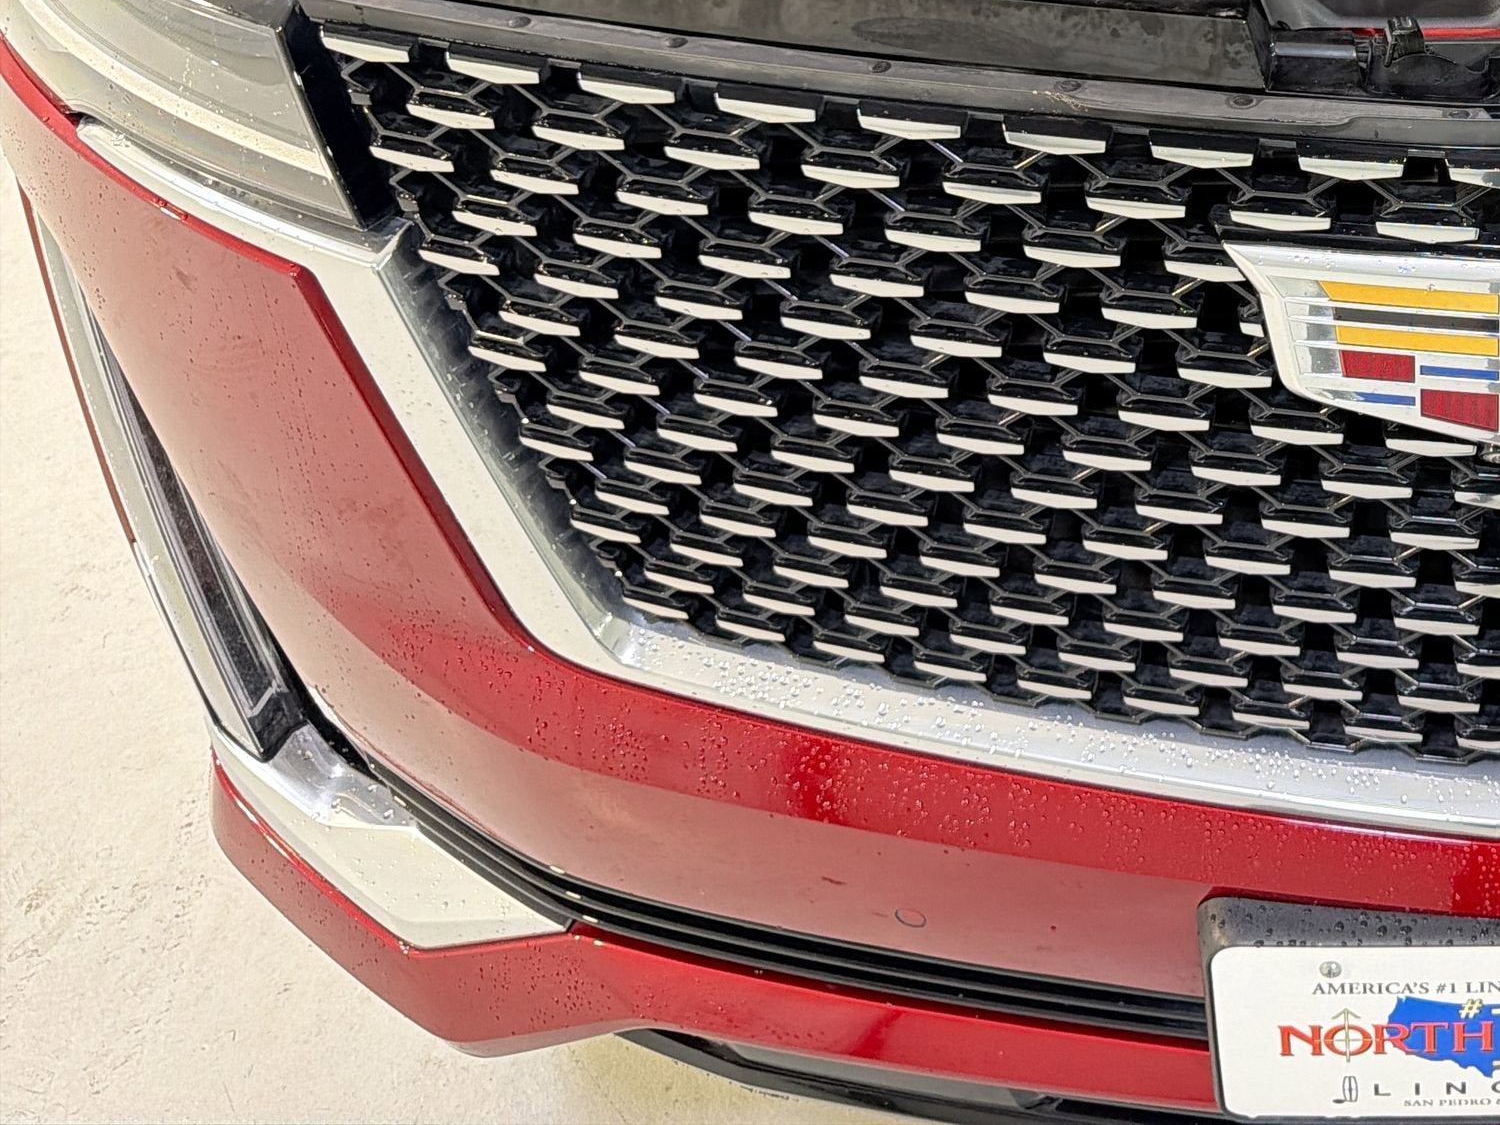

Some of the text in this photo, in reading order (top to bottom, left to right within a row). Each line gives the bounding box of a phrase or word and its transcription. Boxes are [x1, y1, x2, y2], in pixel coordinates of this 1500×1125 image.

[1312, 981, 1430, 996] AMERICA'S
[1436, 982, 1457, 994] #1
[1278, 1020, 1496, 1057] NORTH
[1403, 1099, 1434, 1107] SAN
[1439, 1098, 1493, 1107] PEDRO
